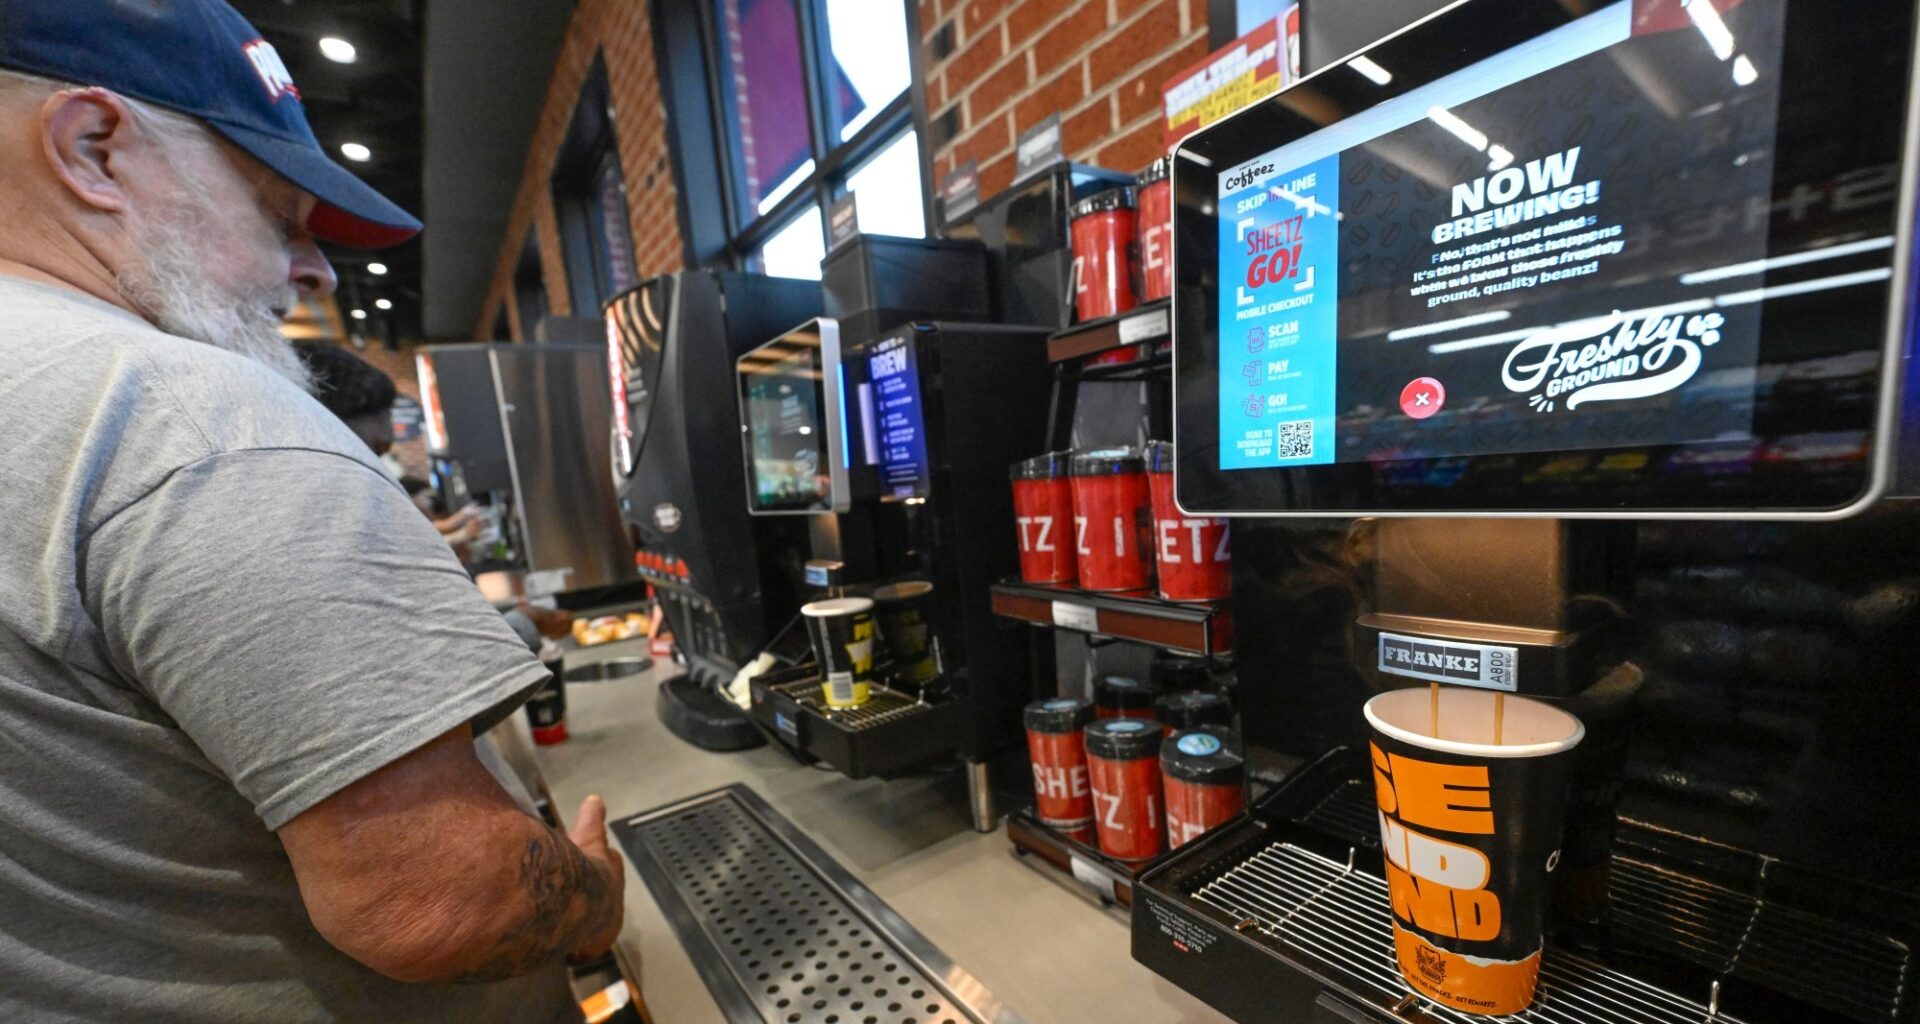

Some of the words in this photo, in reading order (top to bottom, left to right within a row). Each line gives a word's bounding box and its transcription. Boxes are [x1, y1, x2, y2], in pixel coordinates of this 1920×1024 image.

[1226, 163, 1275, 191] Coffeez
[1237, 192, 1267, 215] SKIP
[1284, 172, 1317, 195] LINE
[1451, 146, 1581, 217] NOW
[1431, 179, 1601, 244] BREWING!
[1246, 215, 1304, 256] SHEETZ
[1413, 270, 1435, 283] It's
[1436, 263, 1461, 277] the
[1461, 251, 1506, 271] FOAM
[1507, 242, 1544, 260] that
[1545, 224, 1622, 252] happens
[1511, 227, 1541, 244] not
[1246, 243, 1304, 289] GO!
[1511, 255, 1559, 275] those
[1559, 240, 1625, 265] freshly
[1427, 287, 1481, 308] ground,
[1483, 274, 1538, 296] quality
[1540, 260, 1599, 284] beanz!
[1236, 304, 1267, 321] MOBILE
[1267, 293, 1315, 315] CHECKOUT
[1268, 320, 1299, 338] SCAN
[870, 346, 907, 380] BREW
[1268, 359, 1290, 375] PAY
[1502, 309, 1701, 405] Freshly
[1546, 354, 1640, 397] GROUND
[1268, 392, 1288, 407] GO!
[1018, 516, 1055, 552] TZ
[1154, 517, 1231, 564] ETZ
[1384, 646, 1479, 673] FRANKE
[1490, 651, 1504, 684] A800
[1032, 762, 1088, 799] SHE
